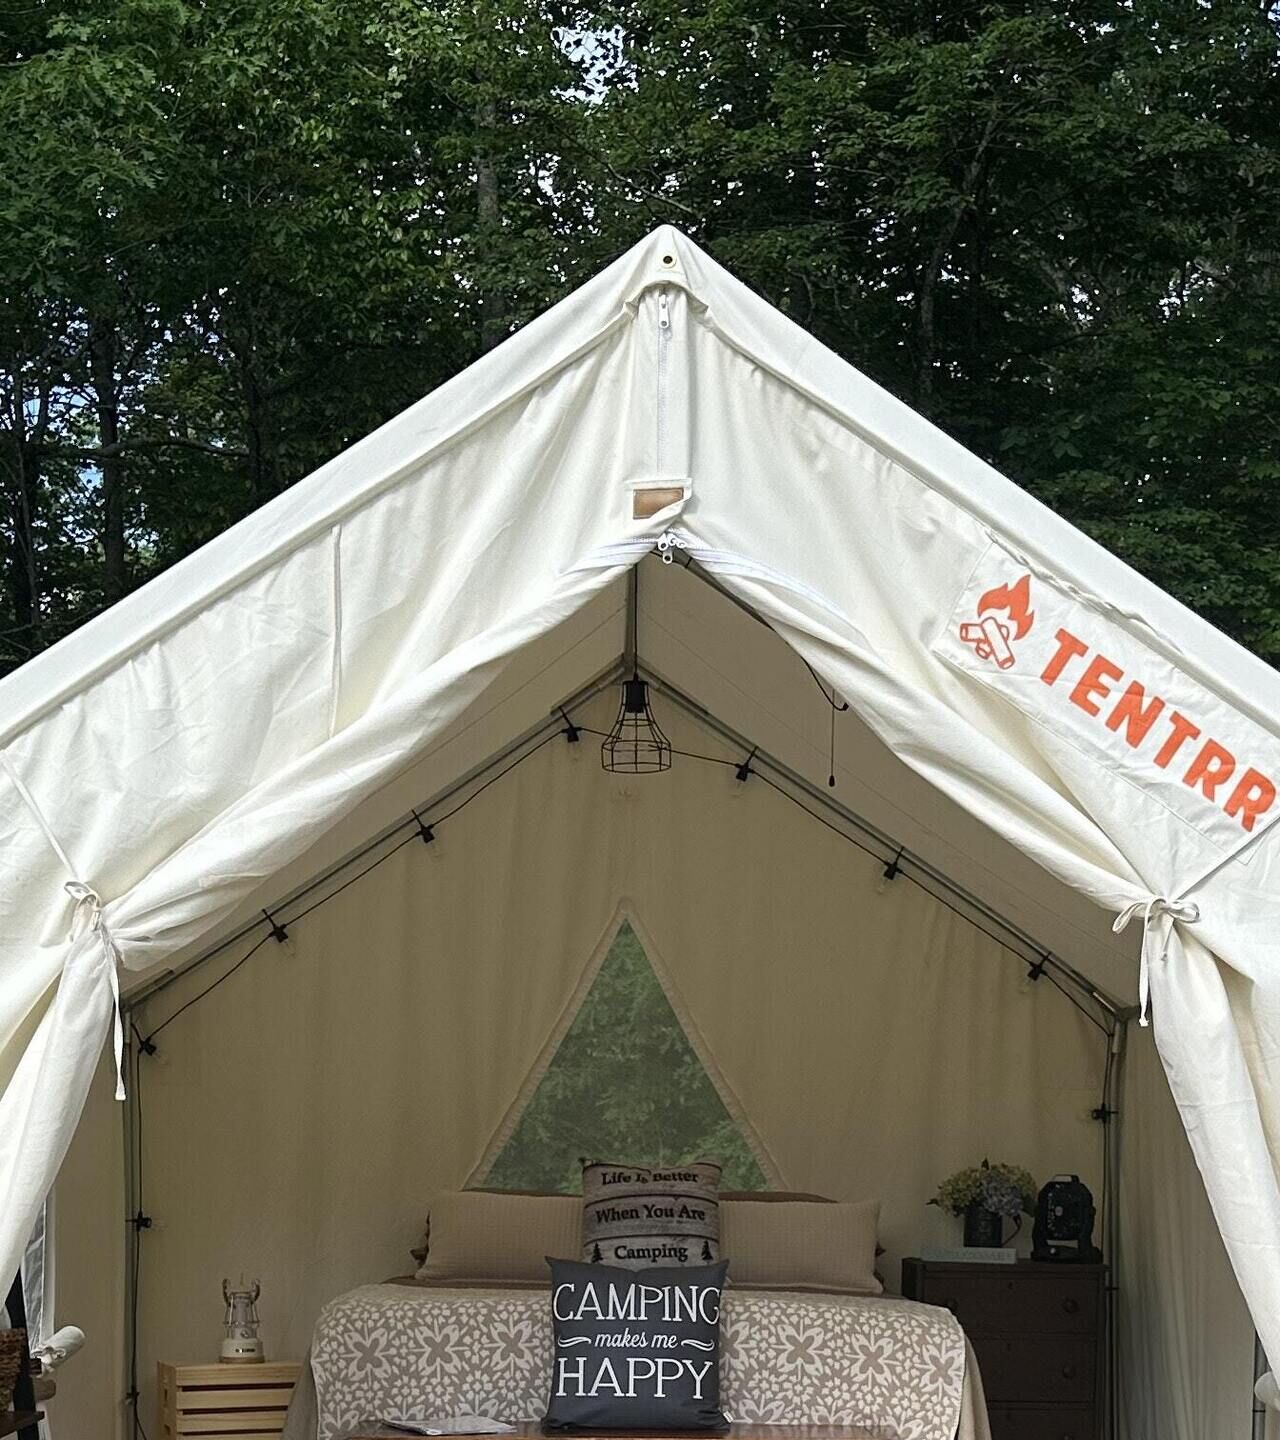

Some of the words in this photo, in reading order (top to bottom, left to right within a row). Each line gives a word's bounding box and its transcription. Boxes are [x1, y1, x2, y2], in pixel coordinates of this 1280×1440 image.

[1040, 628, 1276, 832] TENTRR
[601, 1172, 631, 1186] Life
[652, 1172, 699, 1184] Better
[596, 1208, 640, 1224] When
[643, 1204, 674, 1219] You
[678, 1205, 705, 1221] Are
[614, 1244, 688, 1263] Camping
[553, 1282, 720, 1325] CAMPING
[594, 1328, 649, 1348] makes
[650, 1334, 679, 1348] me
[555, 1357, 713, 1400] HAPPY
